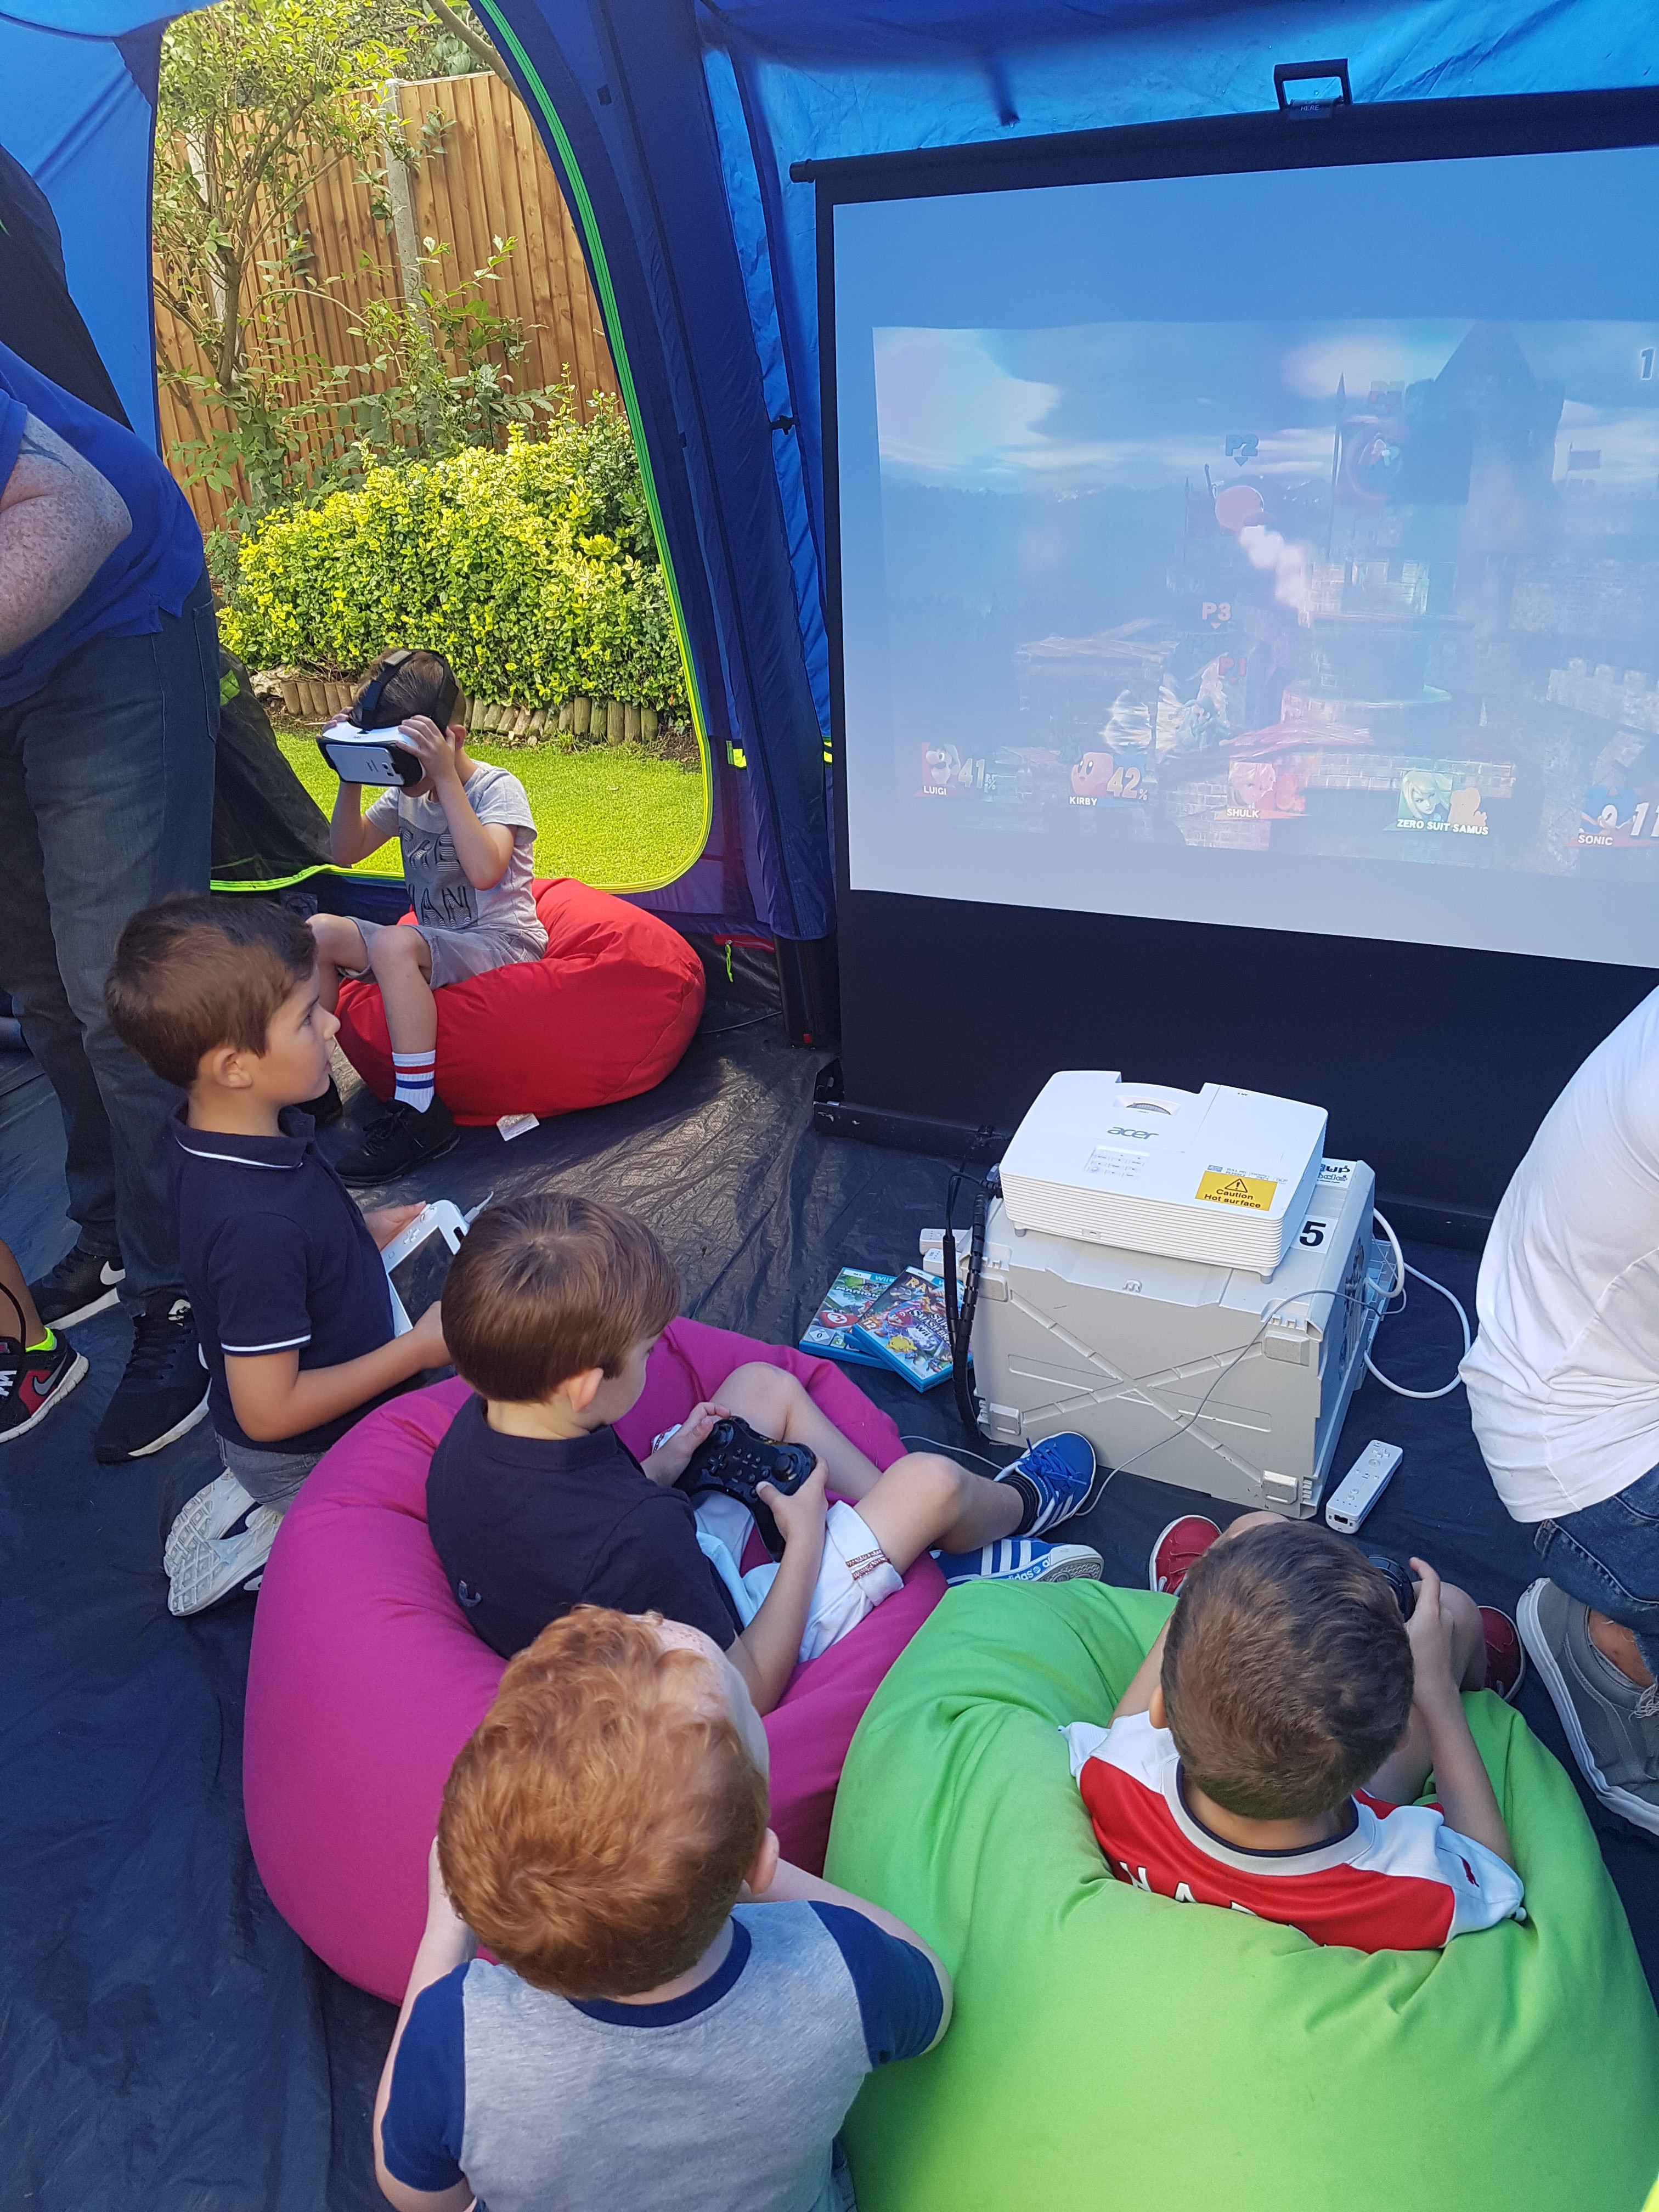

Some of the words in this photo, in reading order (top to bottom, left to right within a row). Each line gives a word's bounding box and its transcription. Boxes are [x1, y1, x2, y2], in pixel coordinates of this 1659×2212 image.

[1225, 433, 1259, 456] P2
[1201, 602, 1232, 621] P3
[1218, 657, 1246, 676] P1
[923, 786, 947, 795] LUIGI
[1069, 795, 1098, 806] KIRBY
[1226, 808, 1259, 818] SHULK
[1397, 819, 1424, 830] ZERO
[1426, 821, 1451, 832] SUIT
[1452, 823, 1489, 835] SAMUS
[1578, 834, 1613, 846] SONIC
[1107, 1126, 1159, 1139] acer
[1216, 1189, 1254, 1200] Caution
[1223, 1198, 1261, 1208] surface
[1299, 1221, 1327, 1246] 5
[863, 1319, 877, 1329] 12
